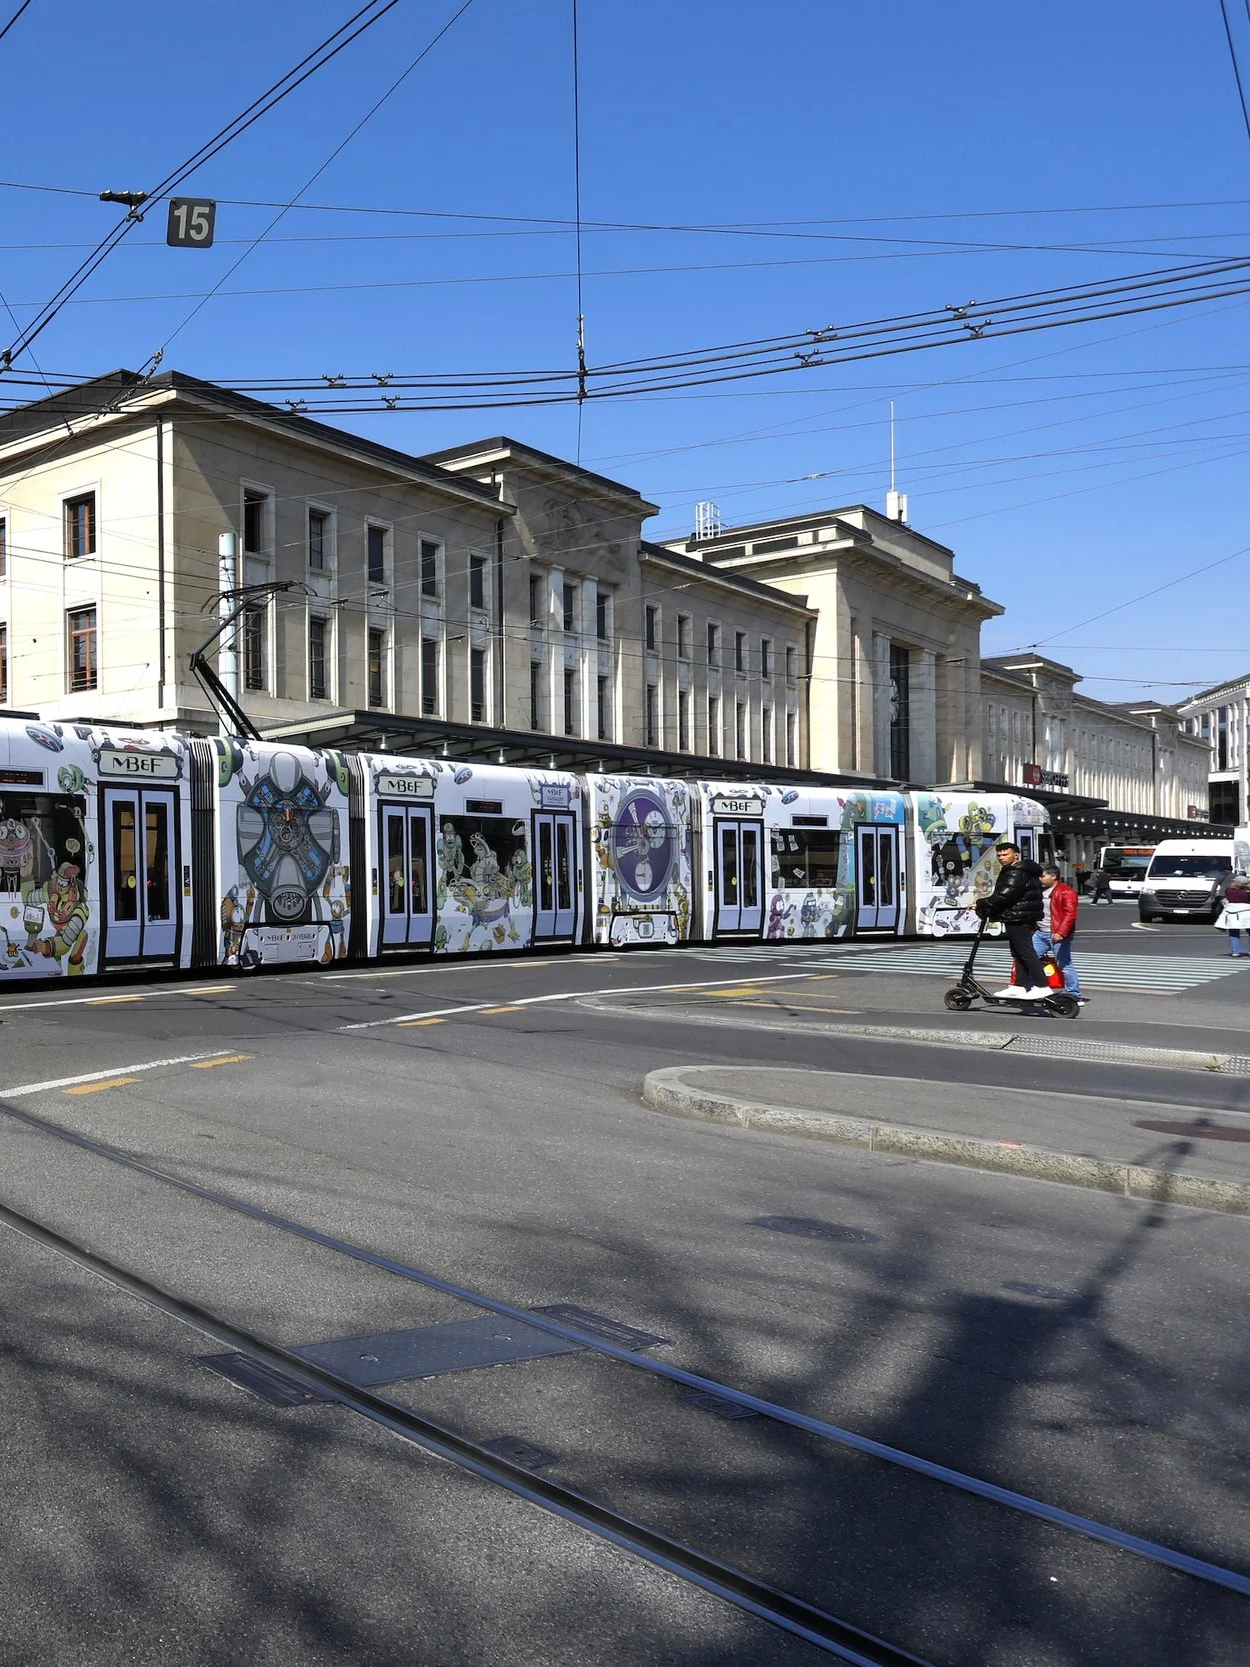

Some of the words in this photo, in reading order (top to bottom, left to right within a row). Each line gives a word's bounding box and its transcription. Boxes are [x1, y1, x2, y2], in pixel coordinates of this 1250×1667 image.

[174, 204, 209, 241] 15
[113, 756, 163, 773] MB&F
[387, 779, 423, 793] MB&F
[722, 800, 753, 812] MB&F
